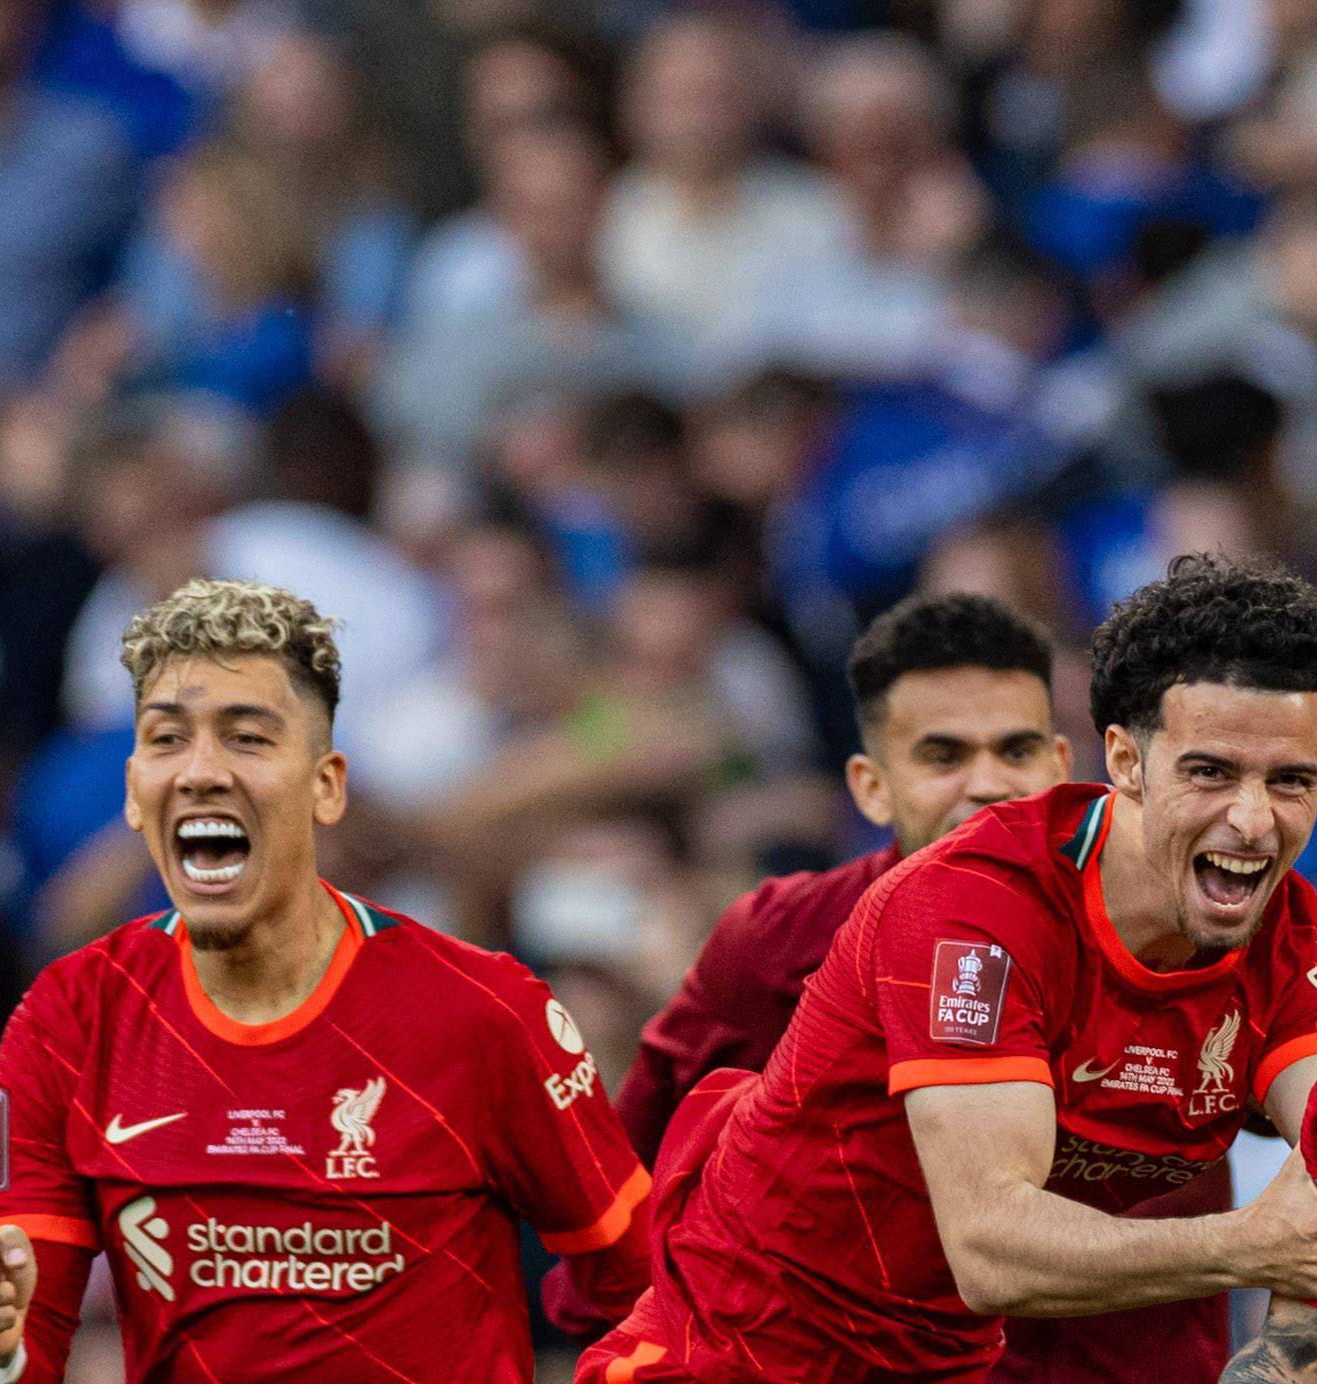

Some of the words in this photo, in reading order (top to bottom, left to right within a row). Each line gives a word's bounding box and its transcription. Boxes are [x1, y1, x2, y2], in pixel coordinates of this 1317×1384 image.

[939, 994, 990, 1013] Emirates
[938, 1008, 954, 1022] FA
[956, 1009, 989, 1026] CUP
[1124, 1045, 1166, 1058] LIVERPOOL
[1166, 1051, 1178, 1059] FC
[1125, 1063, 1158, 1075] CHELSEA
[1159, 1067, 1170, 1076] FC
[1150, 1084, 1167, 1094] CUP
[187, 1217, 391, 1255] standard
[190, 1253, 404, 1291] chartered
